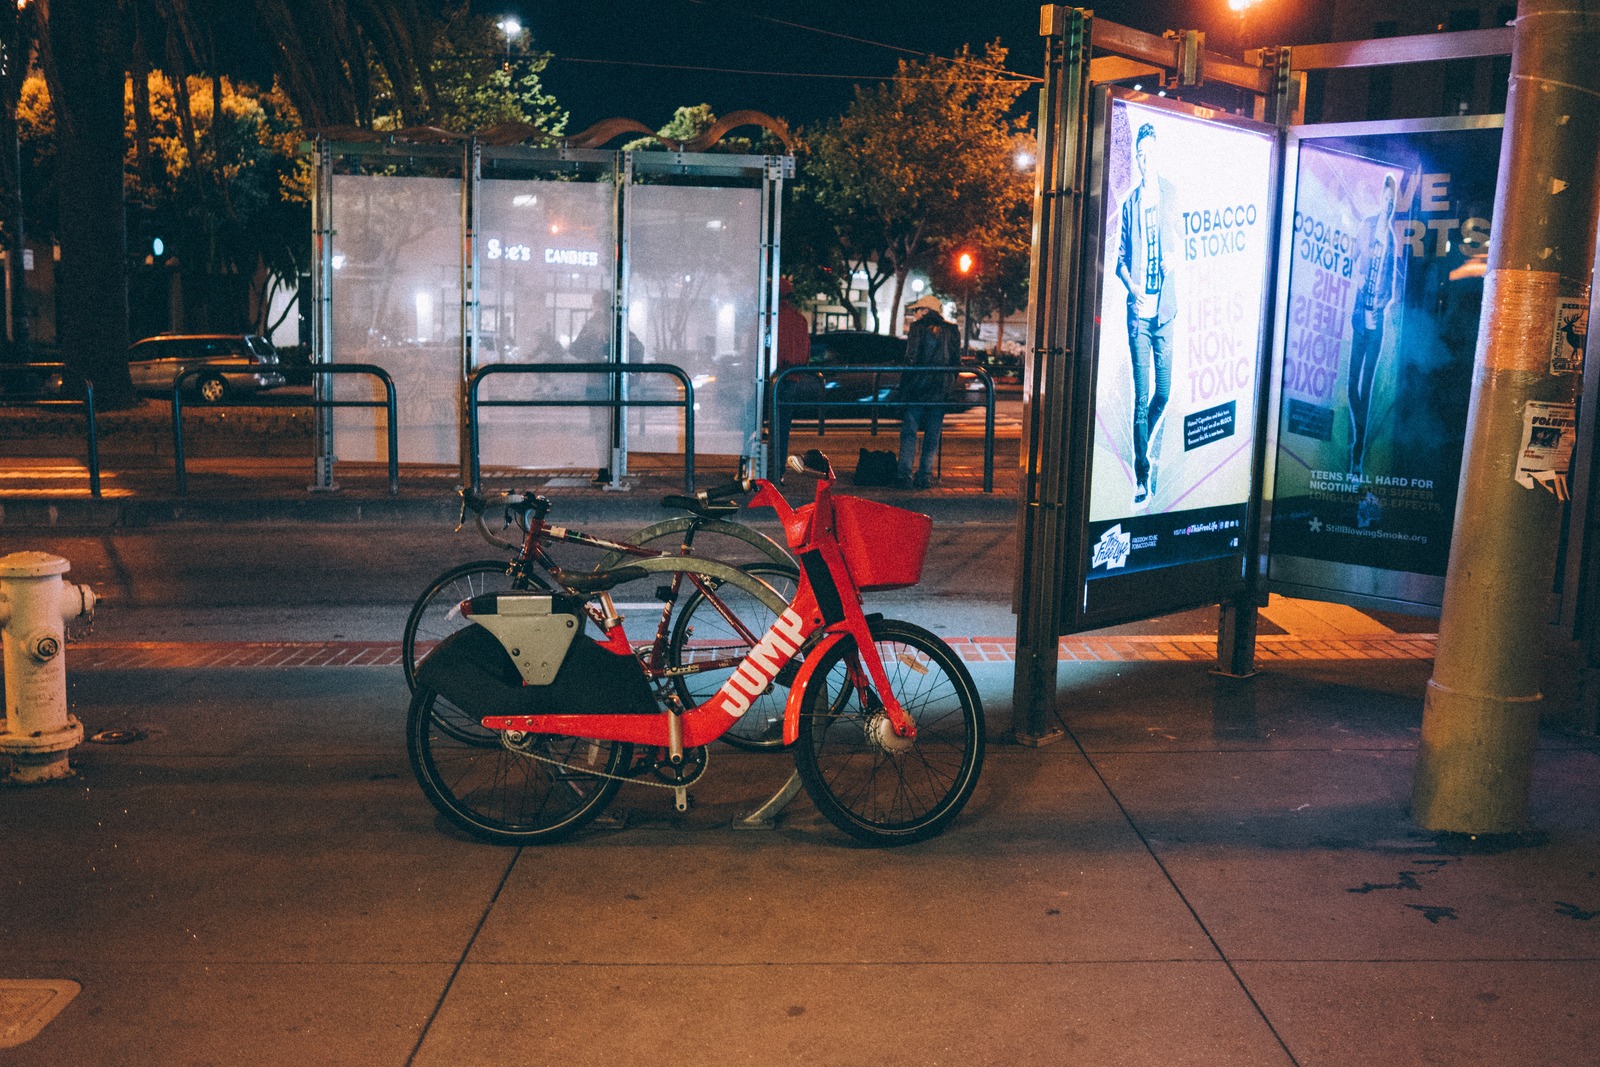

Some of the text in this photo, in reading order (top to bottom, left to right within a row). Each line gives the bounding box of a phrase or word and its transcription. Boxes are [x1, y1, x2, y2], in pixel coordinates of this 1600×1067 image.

[1183, 204, 1257, 235] TOBACCO
[545, 248, 598, 267] CANDIES
[1185, 230, 1246, 261] IS TOXIC
[1188, 291, 1244, 333] LIFE IS
[1188, 331, 1243, 368] NON-
[1188, 357, 1250, 403] TOXIC
[1310, 481, 1359, 494] NICOTINE
[1390, 488, 1434, 500] SUFFER
[1311, 470, 1434, 489] TEENS FALL HARD FOR
[1325, 523, 1428, 545] StillBlowingSmoke.org
[720, 607, 806, 718] JUMP
